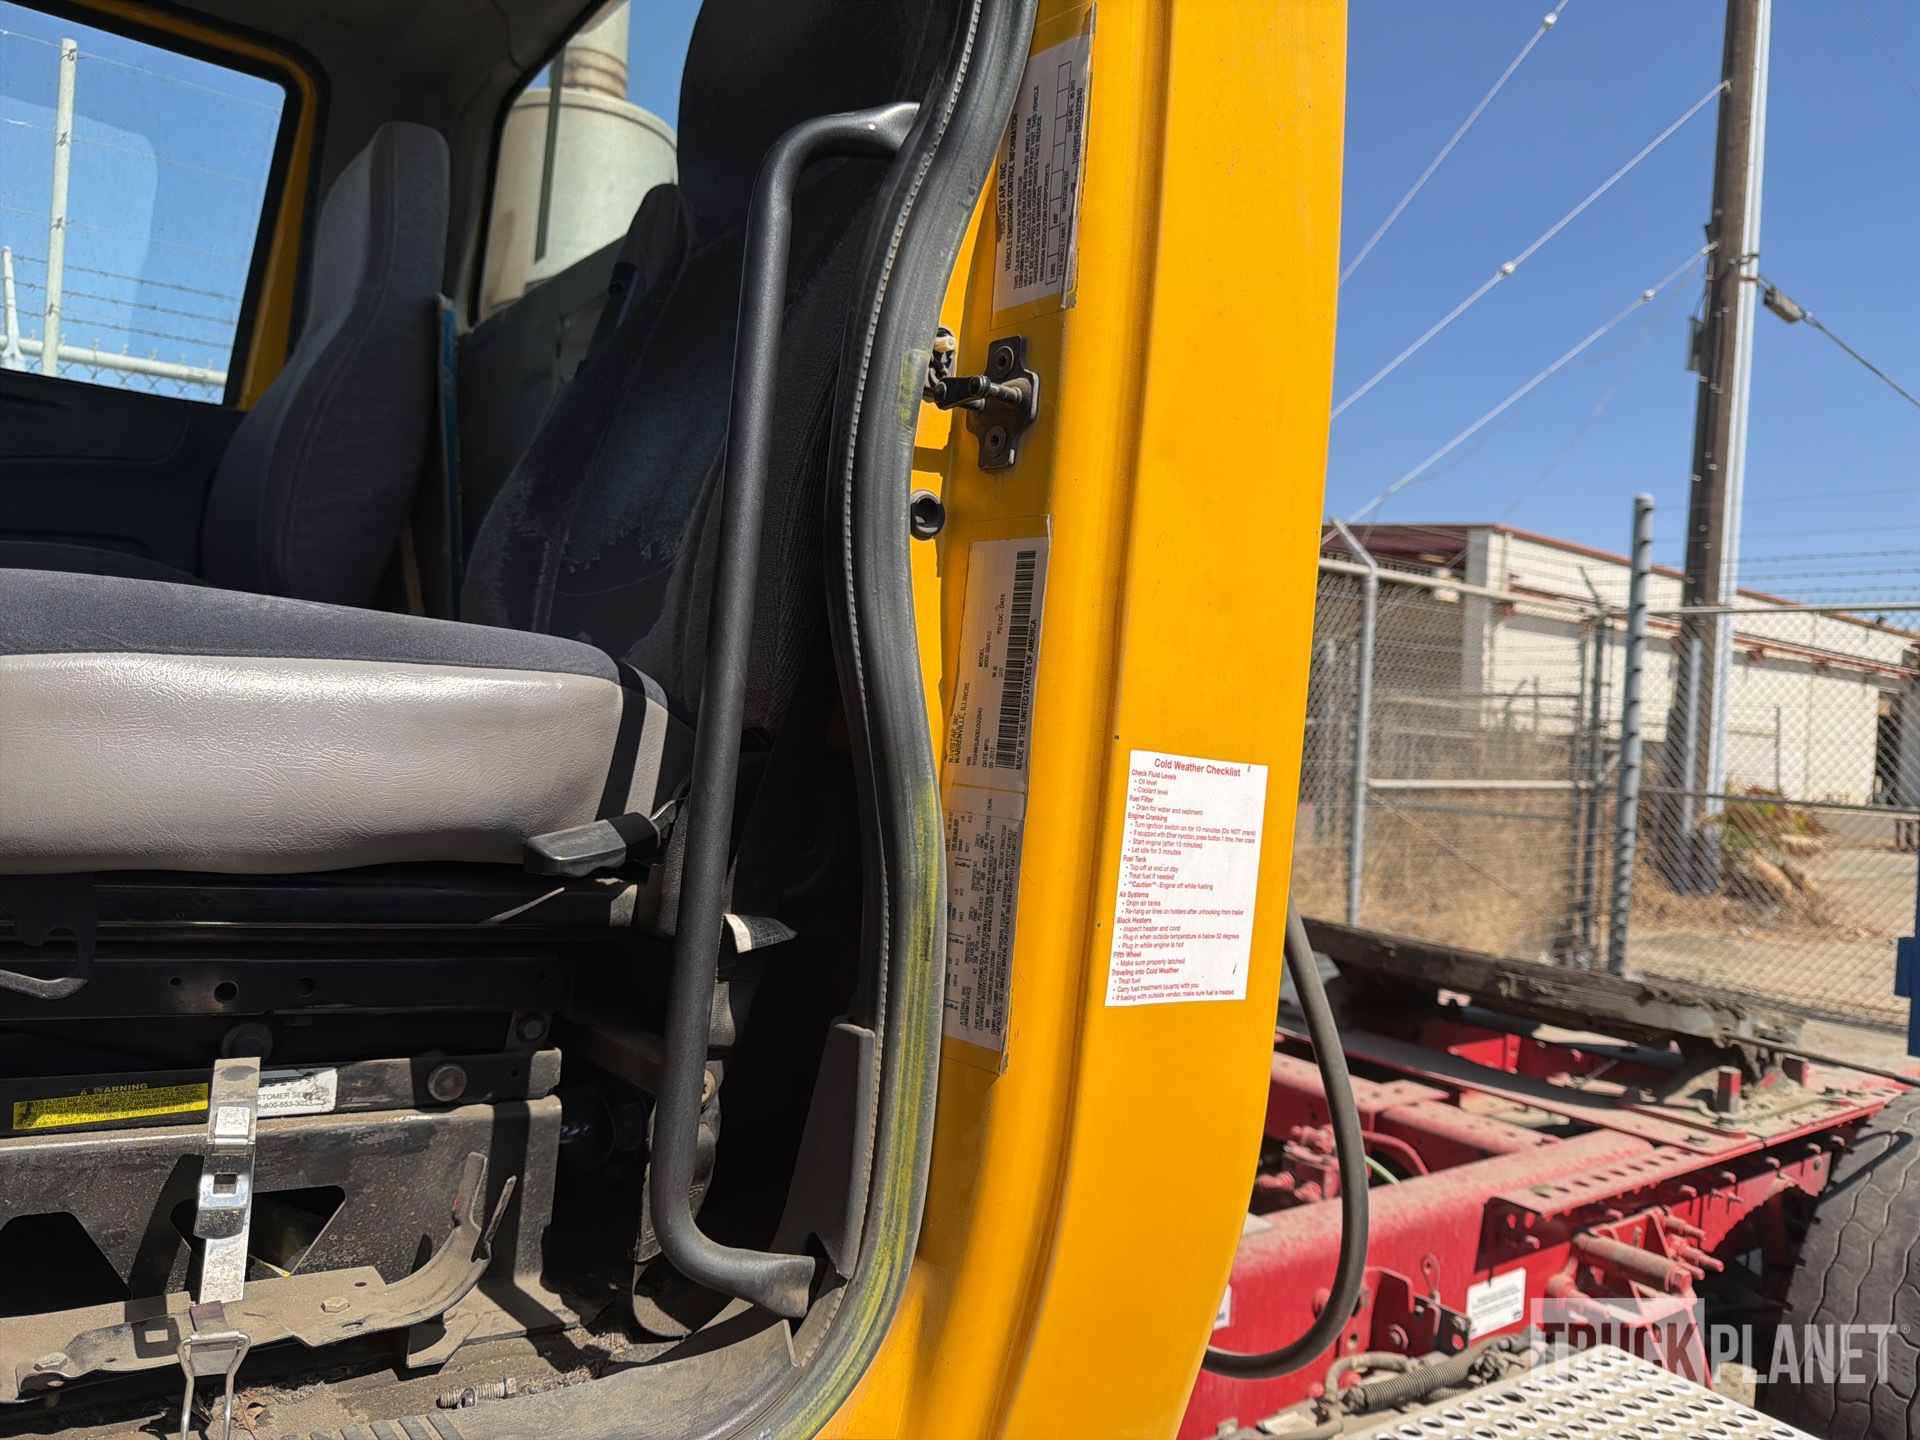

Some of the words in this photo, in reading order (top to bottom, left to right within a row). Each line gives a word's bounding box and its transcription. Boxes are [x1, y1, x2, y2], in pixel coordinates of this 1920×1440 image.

[1004, 239, 1012, 271] VEHICLE
[1027, 618, 1037, 652] AMERICA
[1025, 654, 1033, 664] OF
[1022, 665, 1032, 694] STATES
[960, 681, 970, 710] ILLINOIS
[1020, 695, 1029, 722] UNITED
[1018, 723, 1026, 738] THE
[1014, 748, 1023, 770] MADE
[1154, 758, 1172, 768] Cold
[1173, 760, 1204, 772] Weather
[1205, 764, 1240, 776] Checklist
[1127, 812, 1144, 820] Engine
[1145, 814, 1167, 822] Cranking
